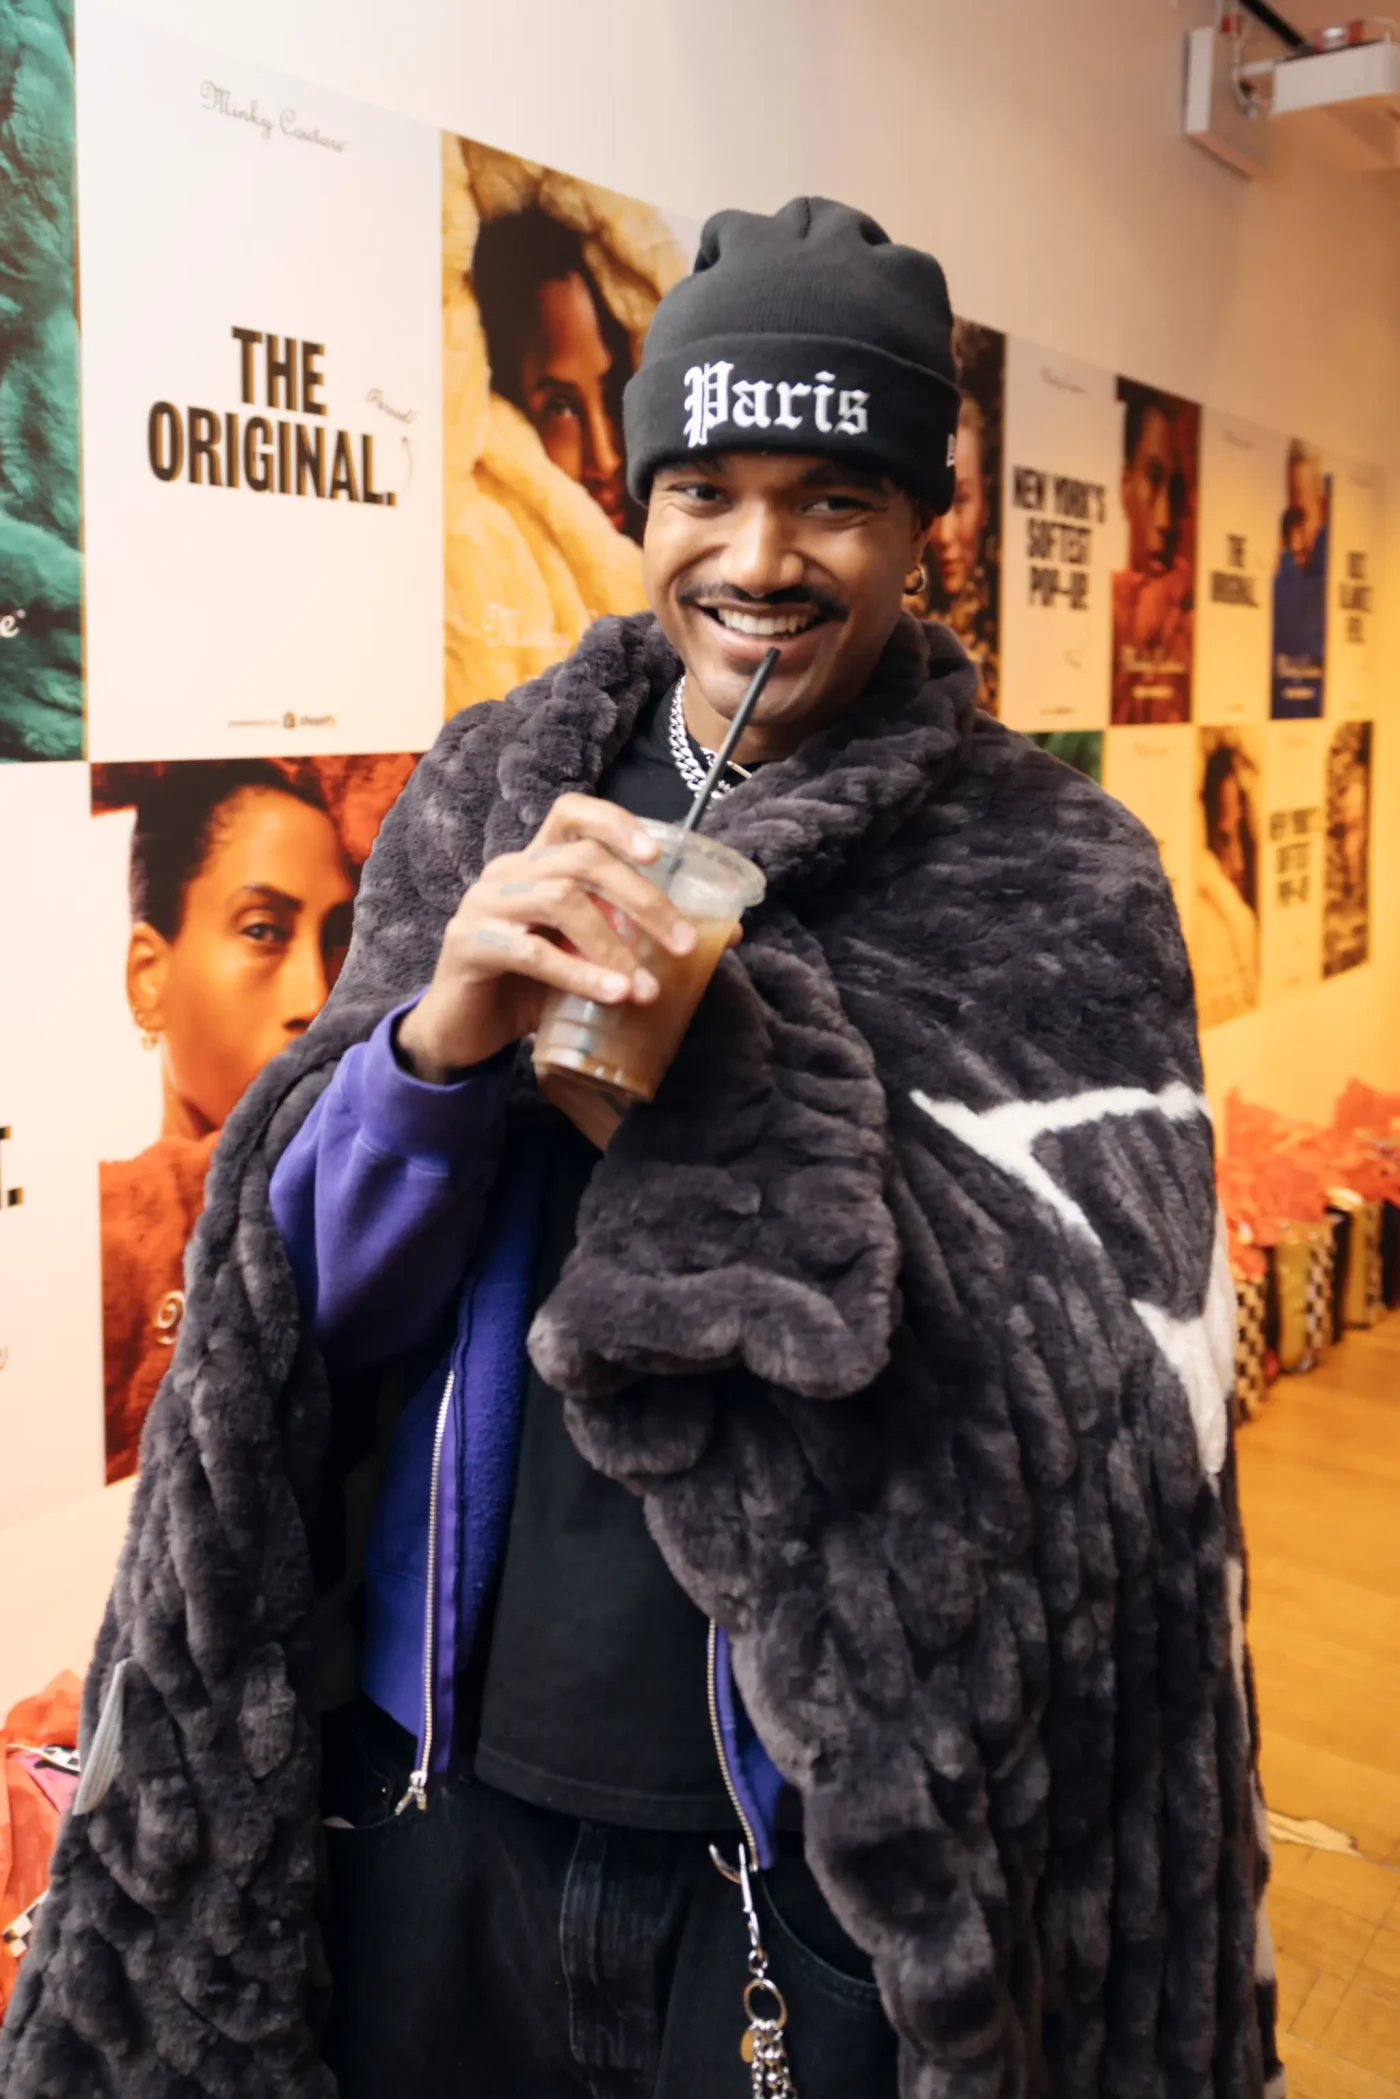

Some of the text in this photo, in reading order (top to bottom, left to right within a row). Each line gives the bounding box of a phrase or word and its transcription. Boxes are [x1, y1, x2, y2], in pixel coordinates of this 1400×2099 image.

[200, 79, 276, 140] Minky
[231, 325, 327, 416] THE
[683, 360, 870, 448] Paris
[147, 401, 397, 507] ORIGINAL.
[1013, 465, 1046, 512] NEW
